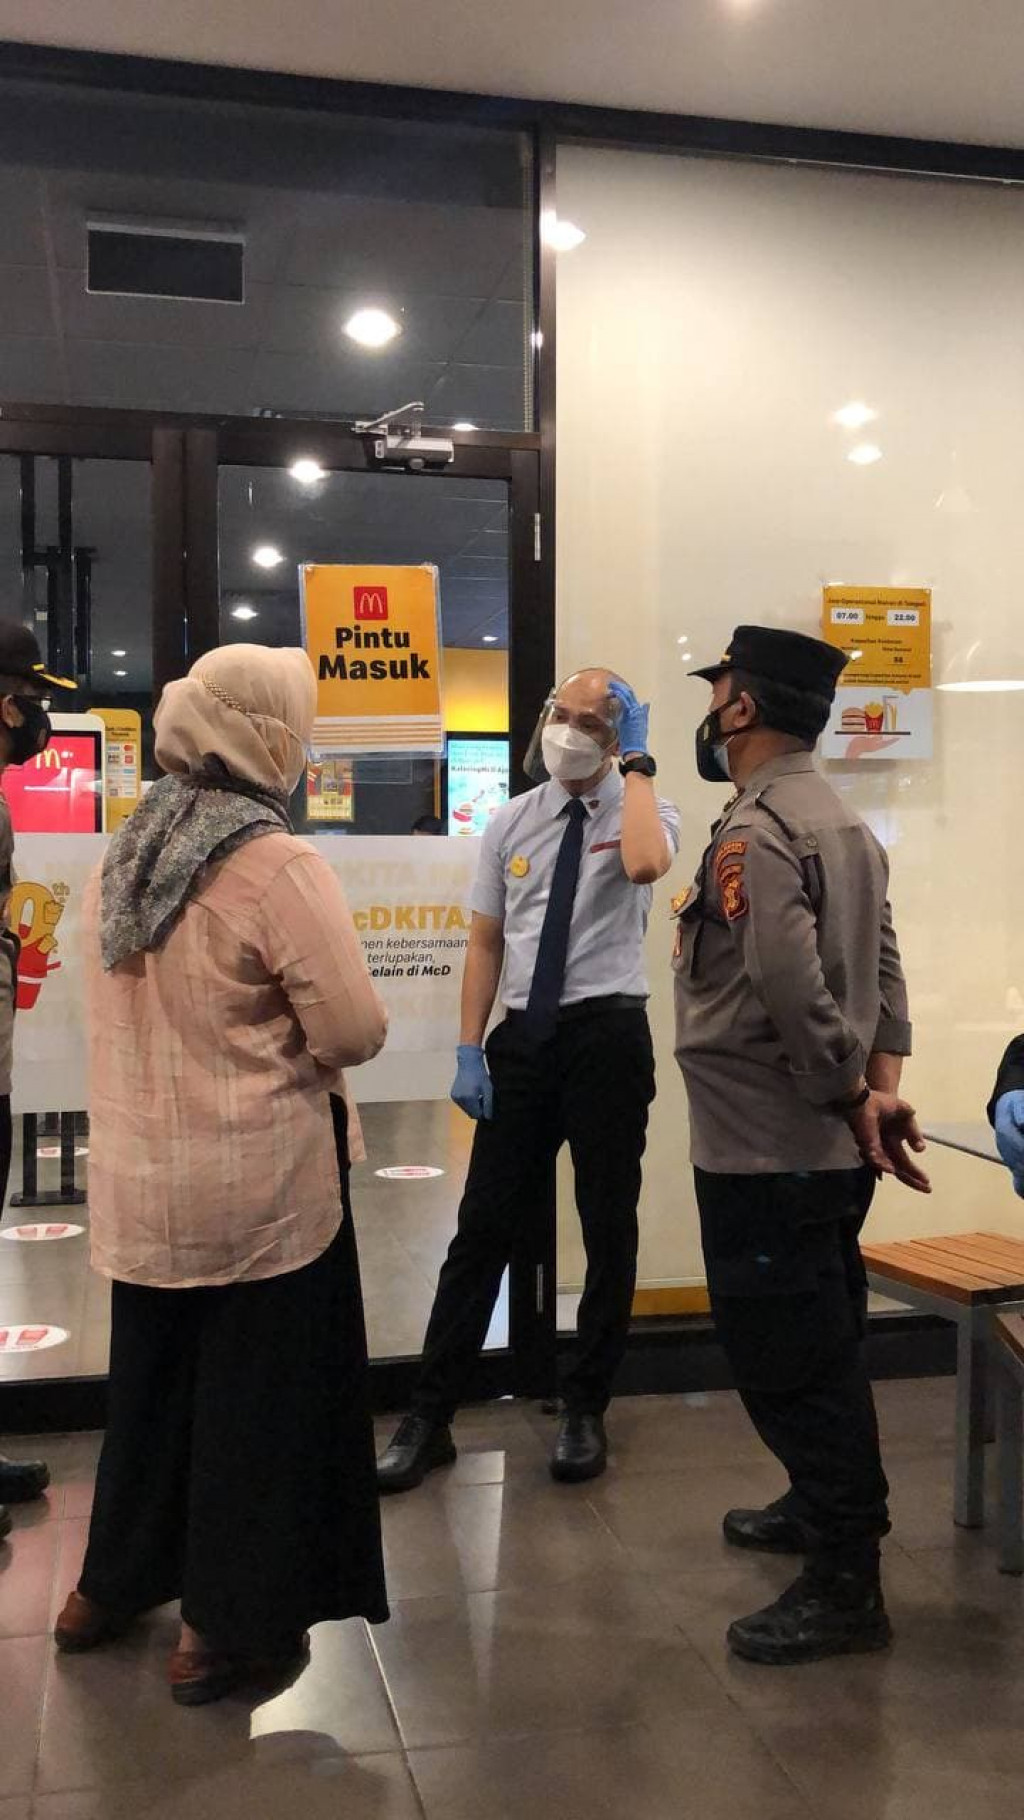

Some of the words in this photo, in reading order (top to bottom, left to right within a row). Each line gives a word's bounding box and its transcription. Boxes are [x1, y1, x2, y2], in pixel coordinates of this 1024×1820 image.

[335, 624, 410, 649] Pintu
[318, 652, 431, 681] Masuk
[386, 938, 468, 949] kebersamaan
[367, 952, 435, 965] terlupakan,
[406, 965, 420, 977] di
[421, 964, 451, 976] McD
